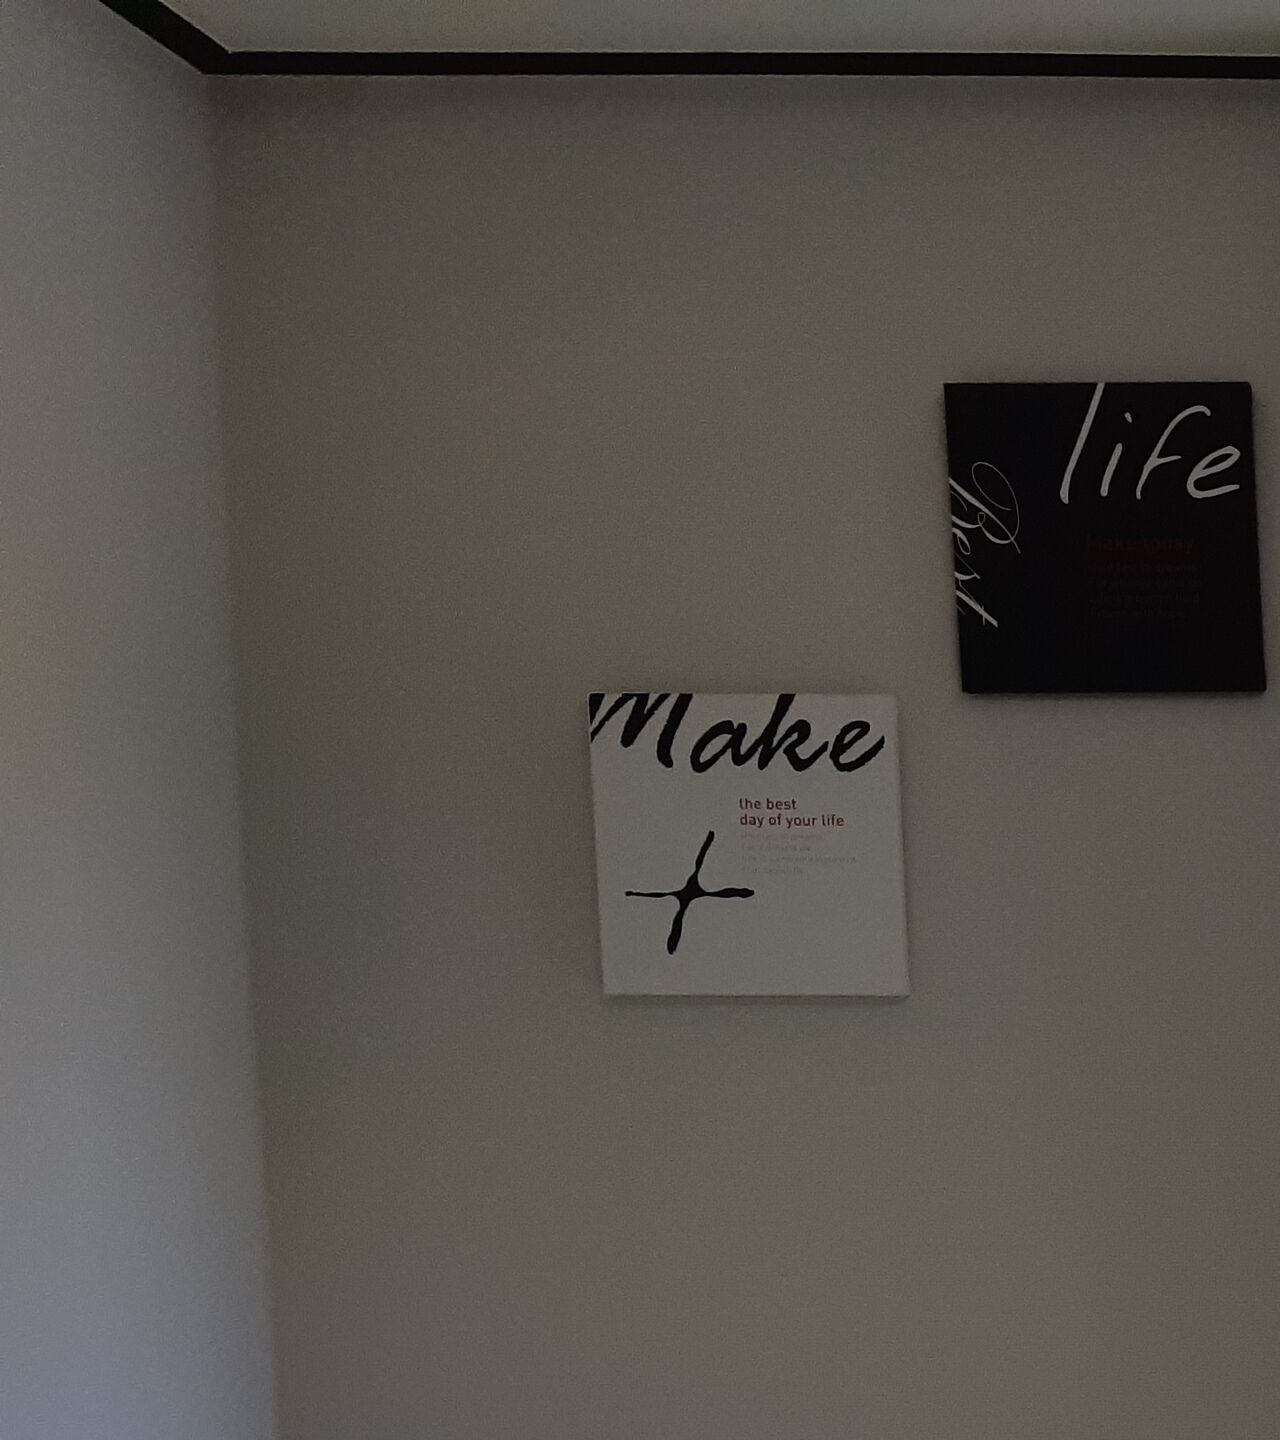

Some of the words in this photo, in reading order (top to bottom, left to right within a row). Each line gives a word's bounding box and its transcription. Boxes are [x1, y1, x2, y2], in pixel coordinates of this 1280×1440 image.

[1059, 382, 1242, 505] life
[588, 692, 885, 774] Make
[739, 797, 762, 811] the
[766, 797, 797, 811] best
[740, 813, 765, 829] day
[768, 813, 783, 826] of
[786, 816, 817, 829] your
[821, 813, 845, 827] life
